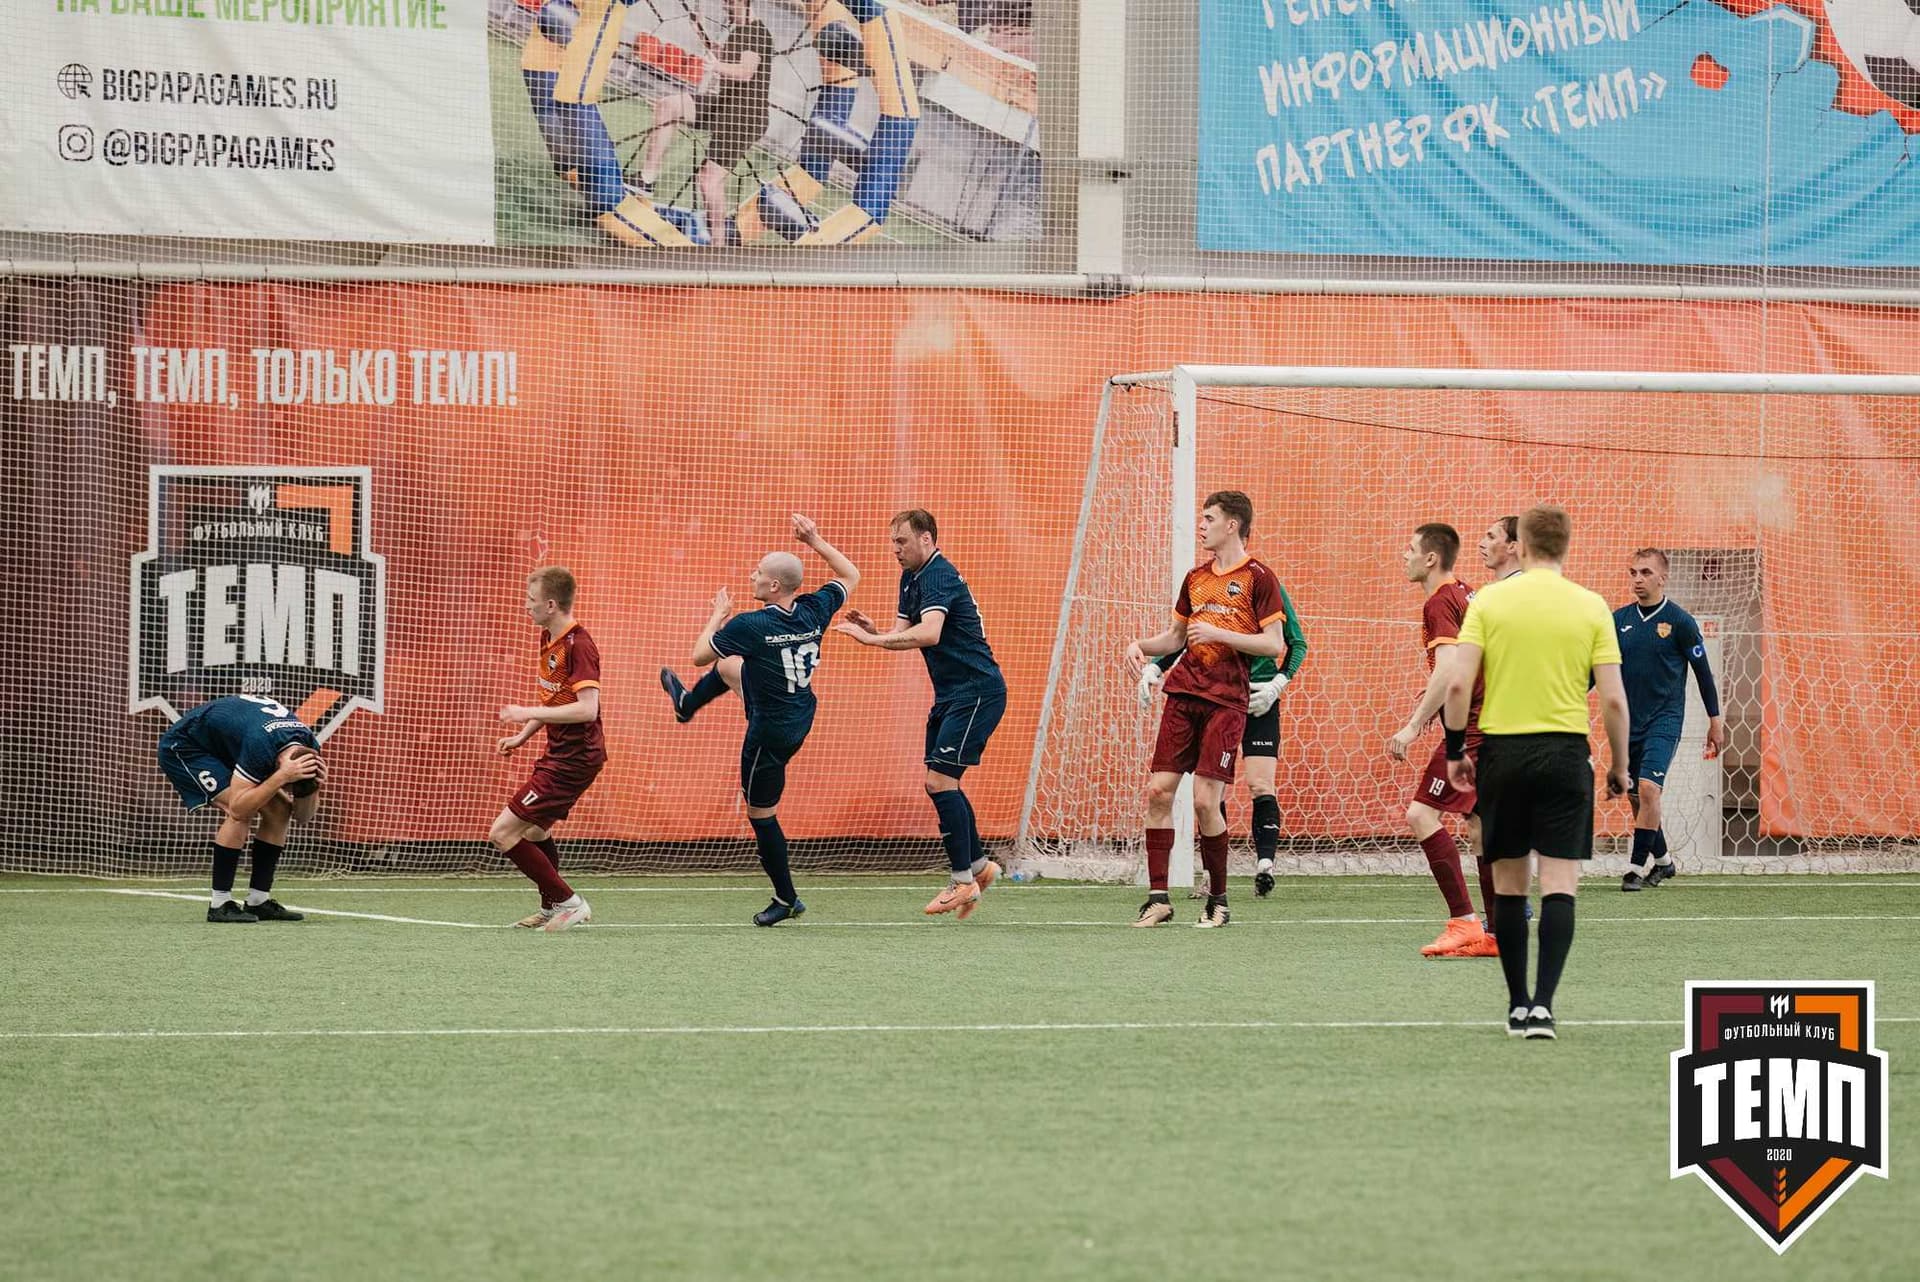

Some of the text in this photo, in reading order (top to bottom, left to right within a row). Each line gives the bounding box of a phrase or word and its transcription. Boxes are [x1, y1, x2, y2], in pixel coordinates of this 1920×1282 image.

[1259, 0, 1641, 116] ИНФОРМАЦИОННЫЙ
[102, 68, 338, 110] BIGPAPAGAMES.RU
[103, 128, 336, 172] @BIGPAPAGAMES
[1256, 67, 1668, 195] ПАРТНЕР ФК «ТЕМП»
[9, 344, 518, 411] ТЕМП, ТЕМП, ТОЛЬКО ТЕМП!
[193, 518, 325, 542] ФУТБОЛЬНЫЙ КЛУБ
[159, 563, 360, 676] ТЕМП
[241, 677, 272, 693] 2020
[781, 641, 821, 694] 10
[198, 770, 218, 792] 6
[1220, 751, 1231, 769] 18
[521, 789, 538, 806] 17
[1429, 777, 1445, 796] 19
